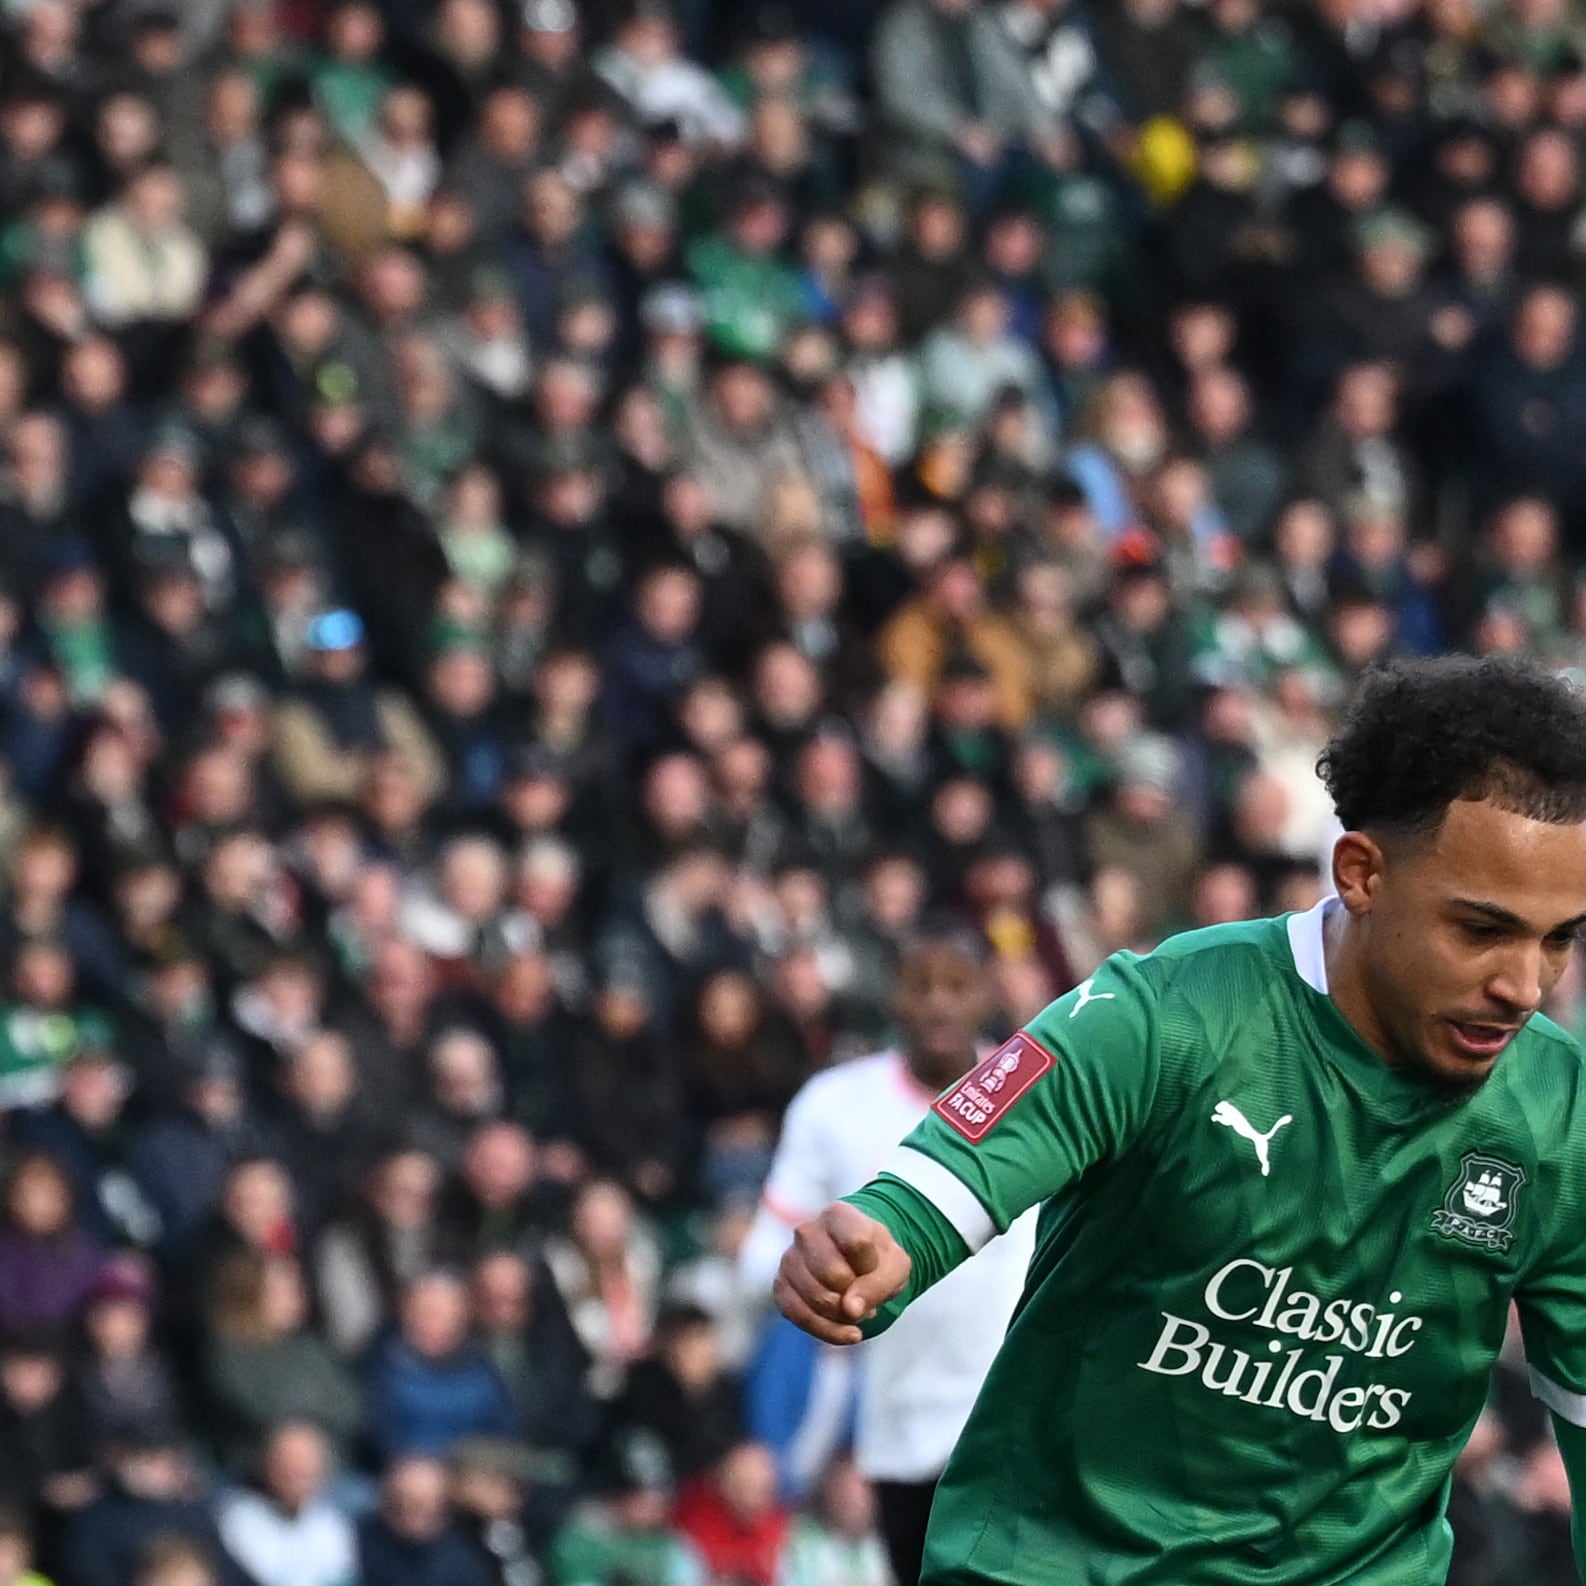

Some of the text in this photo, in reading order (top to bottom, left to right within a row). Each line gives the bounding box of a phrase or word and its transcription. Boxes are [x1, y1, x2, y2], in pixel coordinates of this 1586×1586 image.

[960, 1081, 996, 1114] Emirates
[1204, 1258, 1423, 1358] Classic
[1136, 1311, 1413, 1434] Builders
